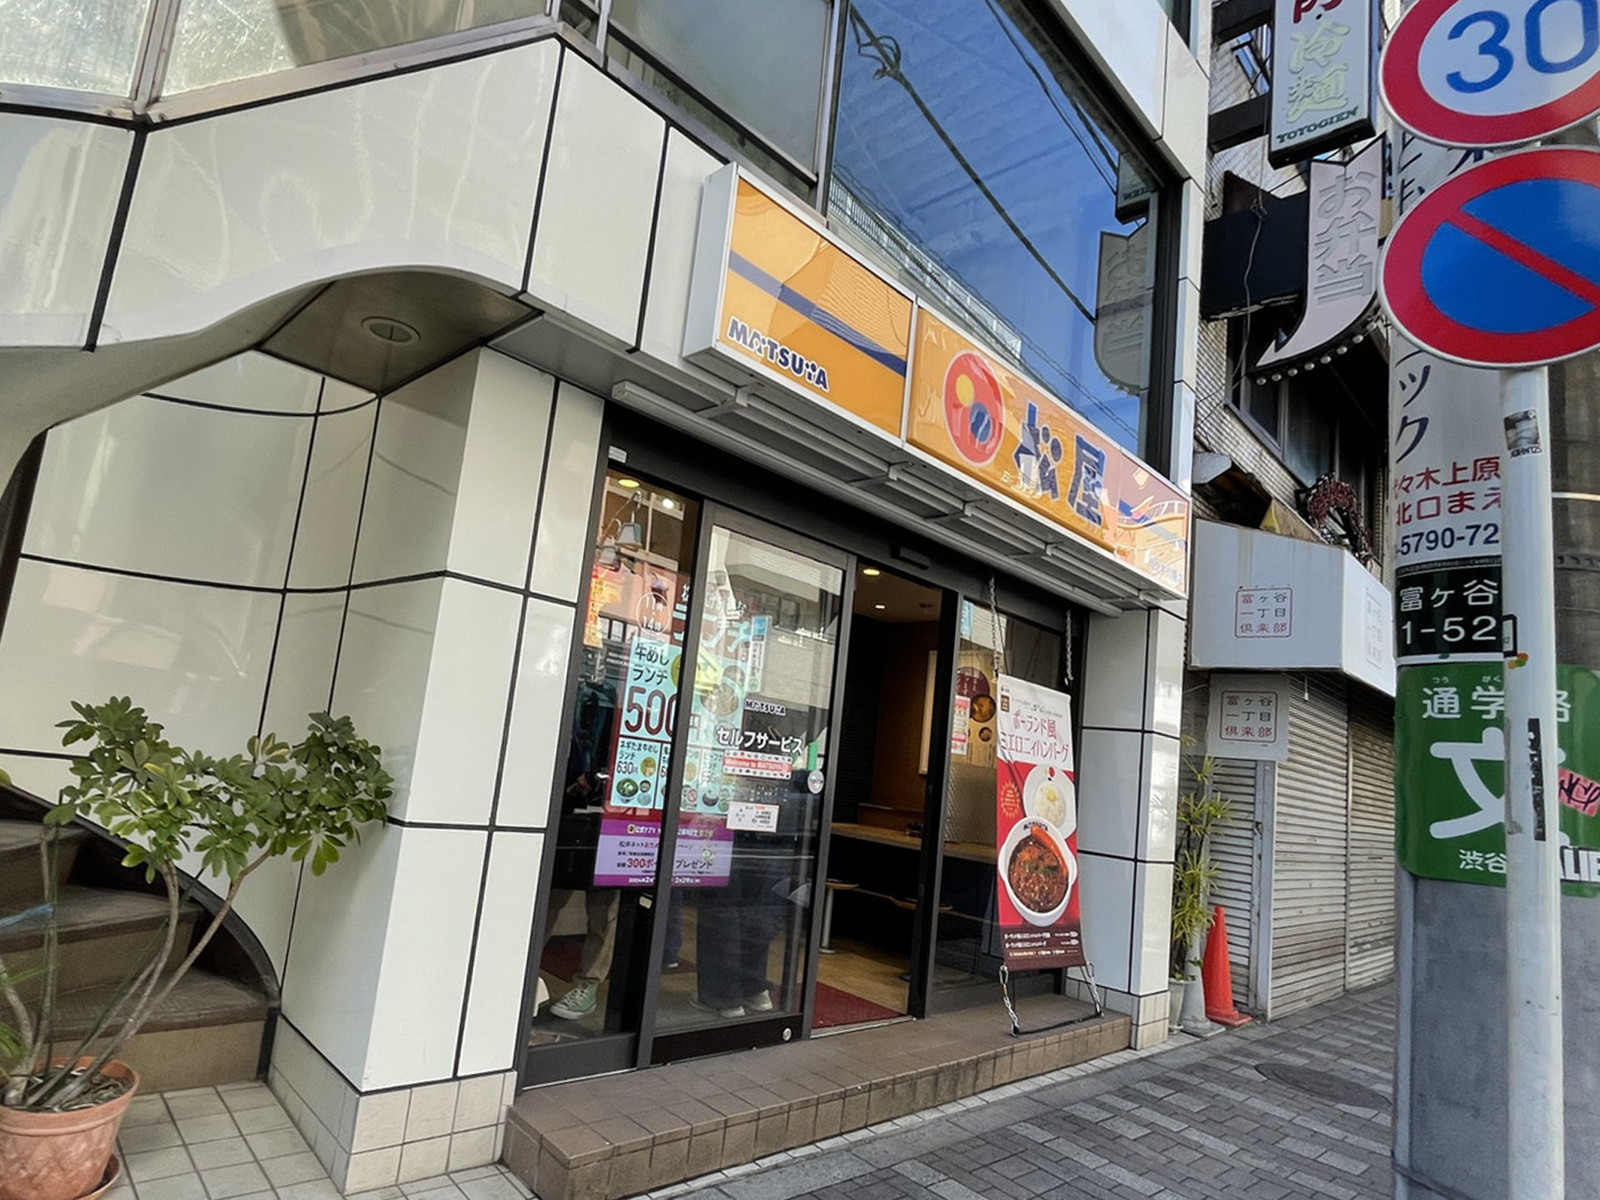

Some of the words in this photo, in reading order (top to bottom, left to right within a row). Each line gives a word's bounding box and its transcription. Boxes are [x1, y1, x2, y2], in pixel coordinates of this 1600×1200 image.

[1446, 0, 1600, 94] 30
[1314, 171, 1377, 303] お弁当
[727, 316, 829, 393] MATSUYA
[1013, 401, 1108, 527] 松屋
[1394, 456, 1501, 499] 々木上原
[1402, 615, 1497, 645] 1-52
[634, 643, 671, 667] 牛めし
[632, 667, 669, 686] ランチ
[717, 726, 804, 754] セルフサービス
[1012, 709, 1057, 740] ポーランド風
